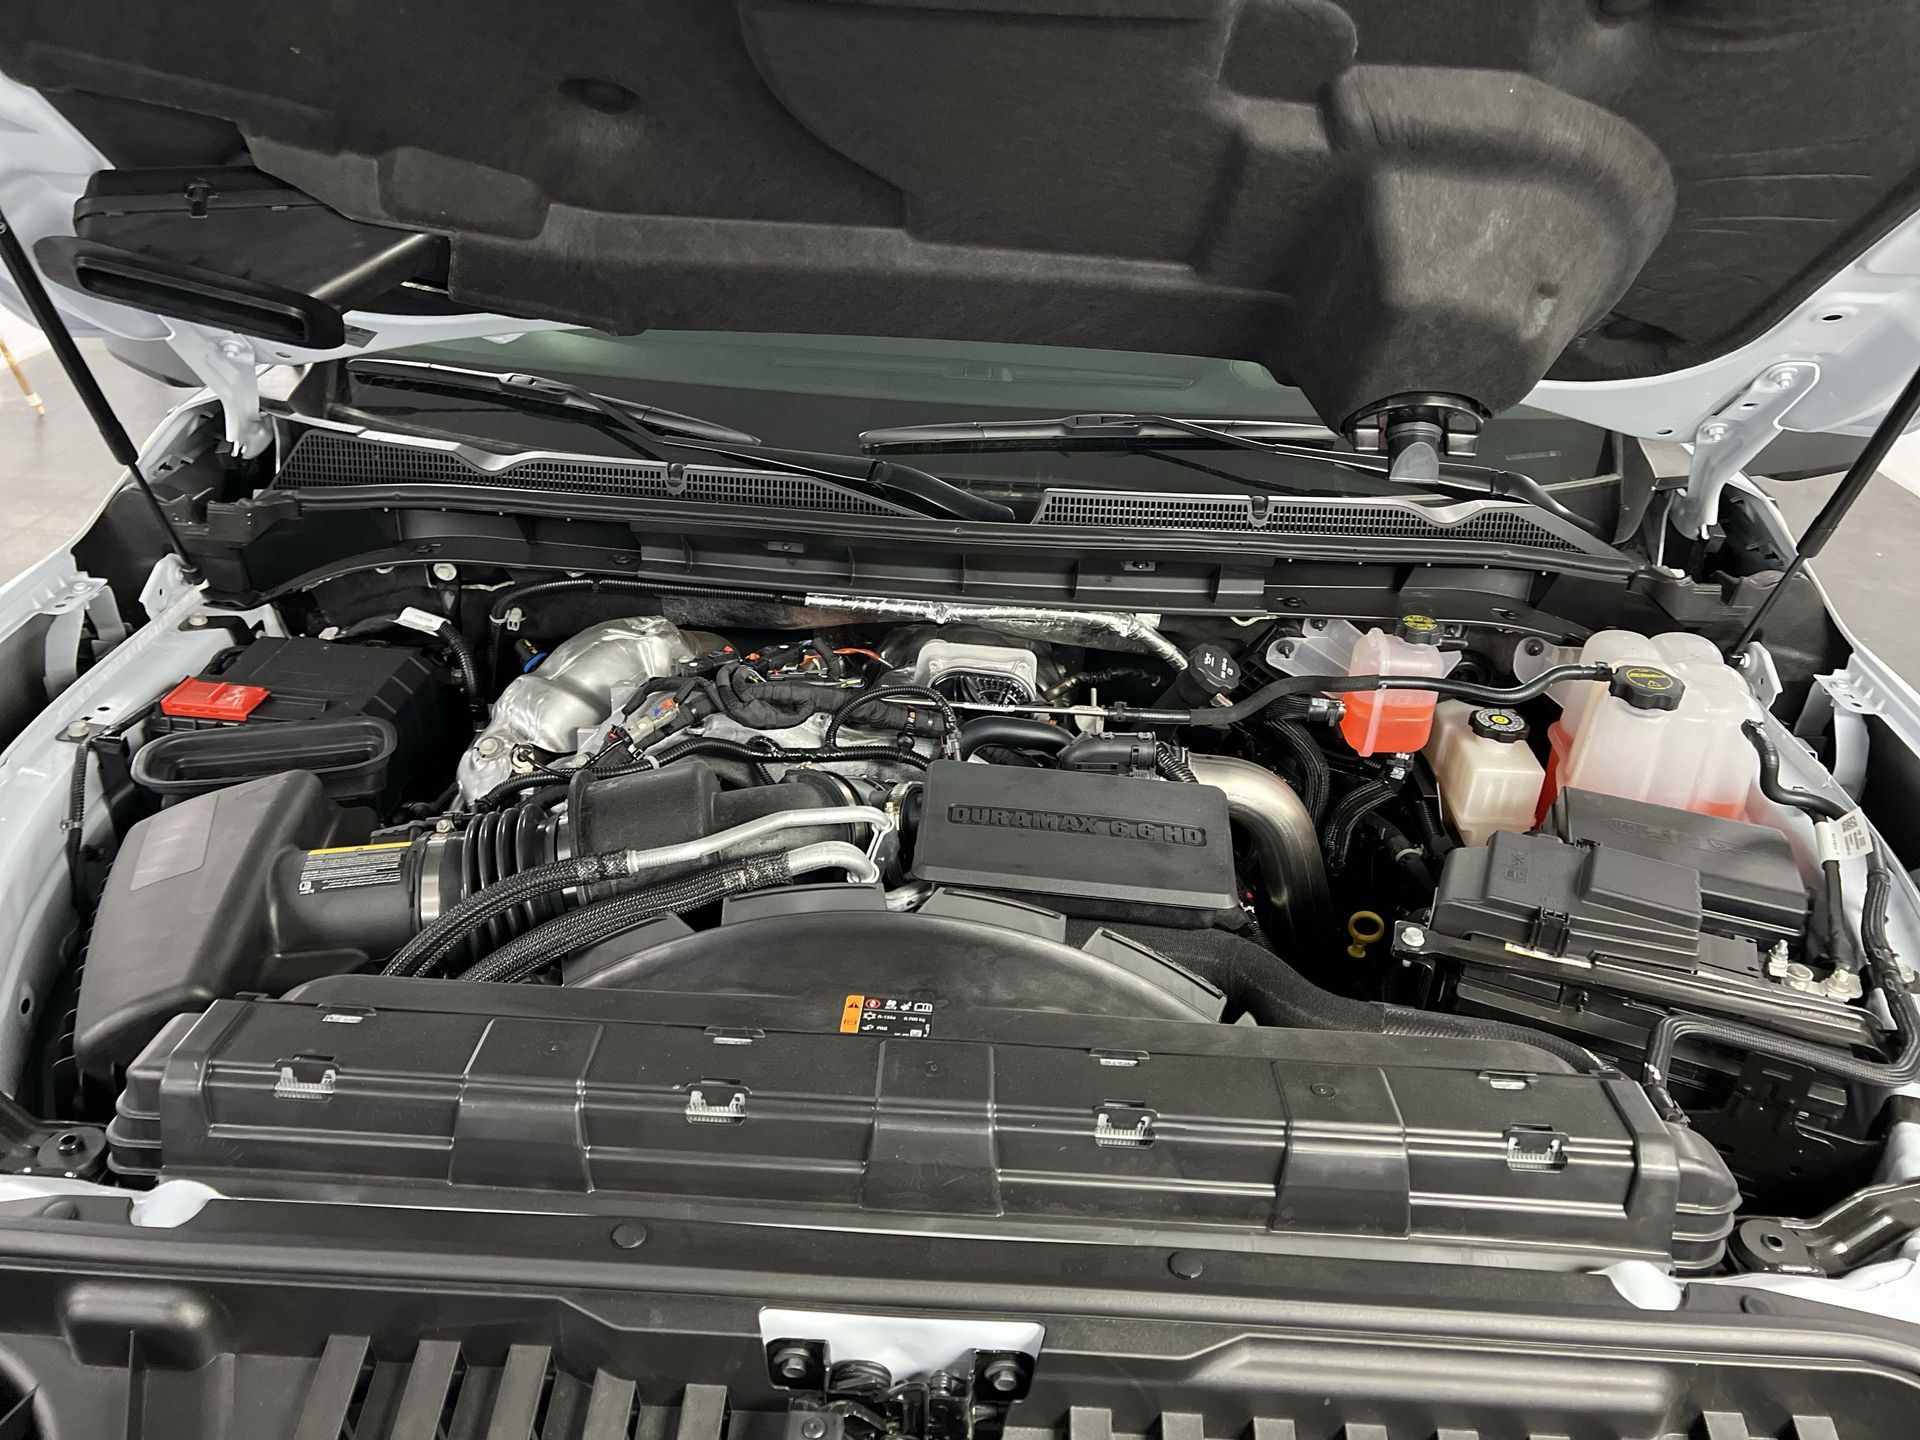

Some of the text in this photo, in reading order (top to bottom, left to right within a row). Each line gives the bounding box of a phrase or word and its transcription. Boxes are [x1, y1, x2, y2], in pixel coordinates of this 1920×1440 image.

[951, 806, 1204, 846] DURAMAX 6.6 HD
